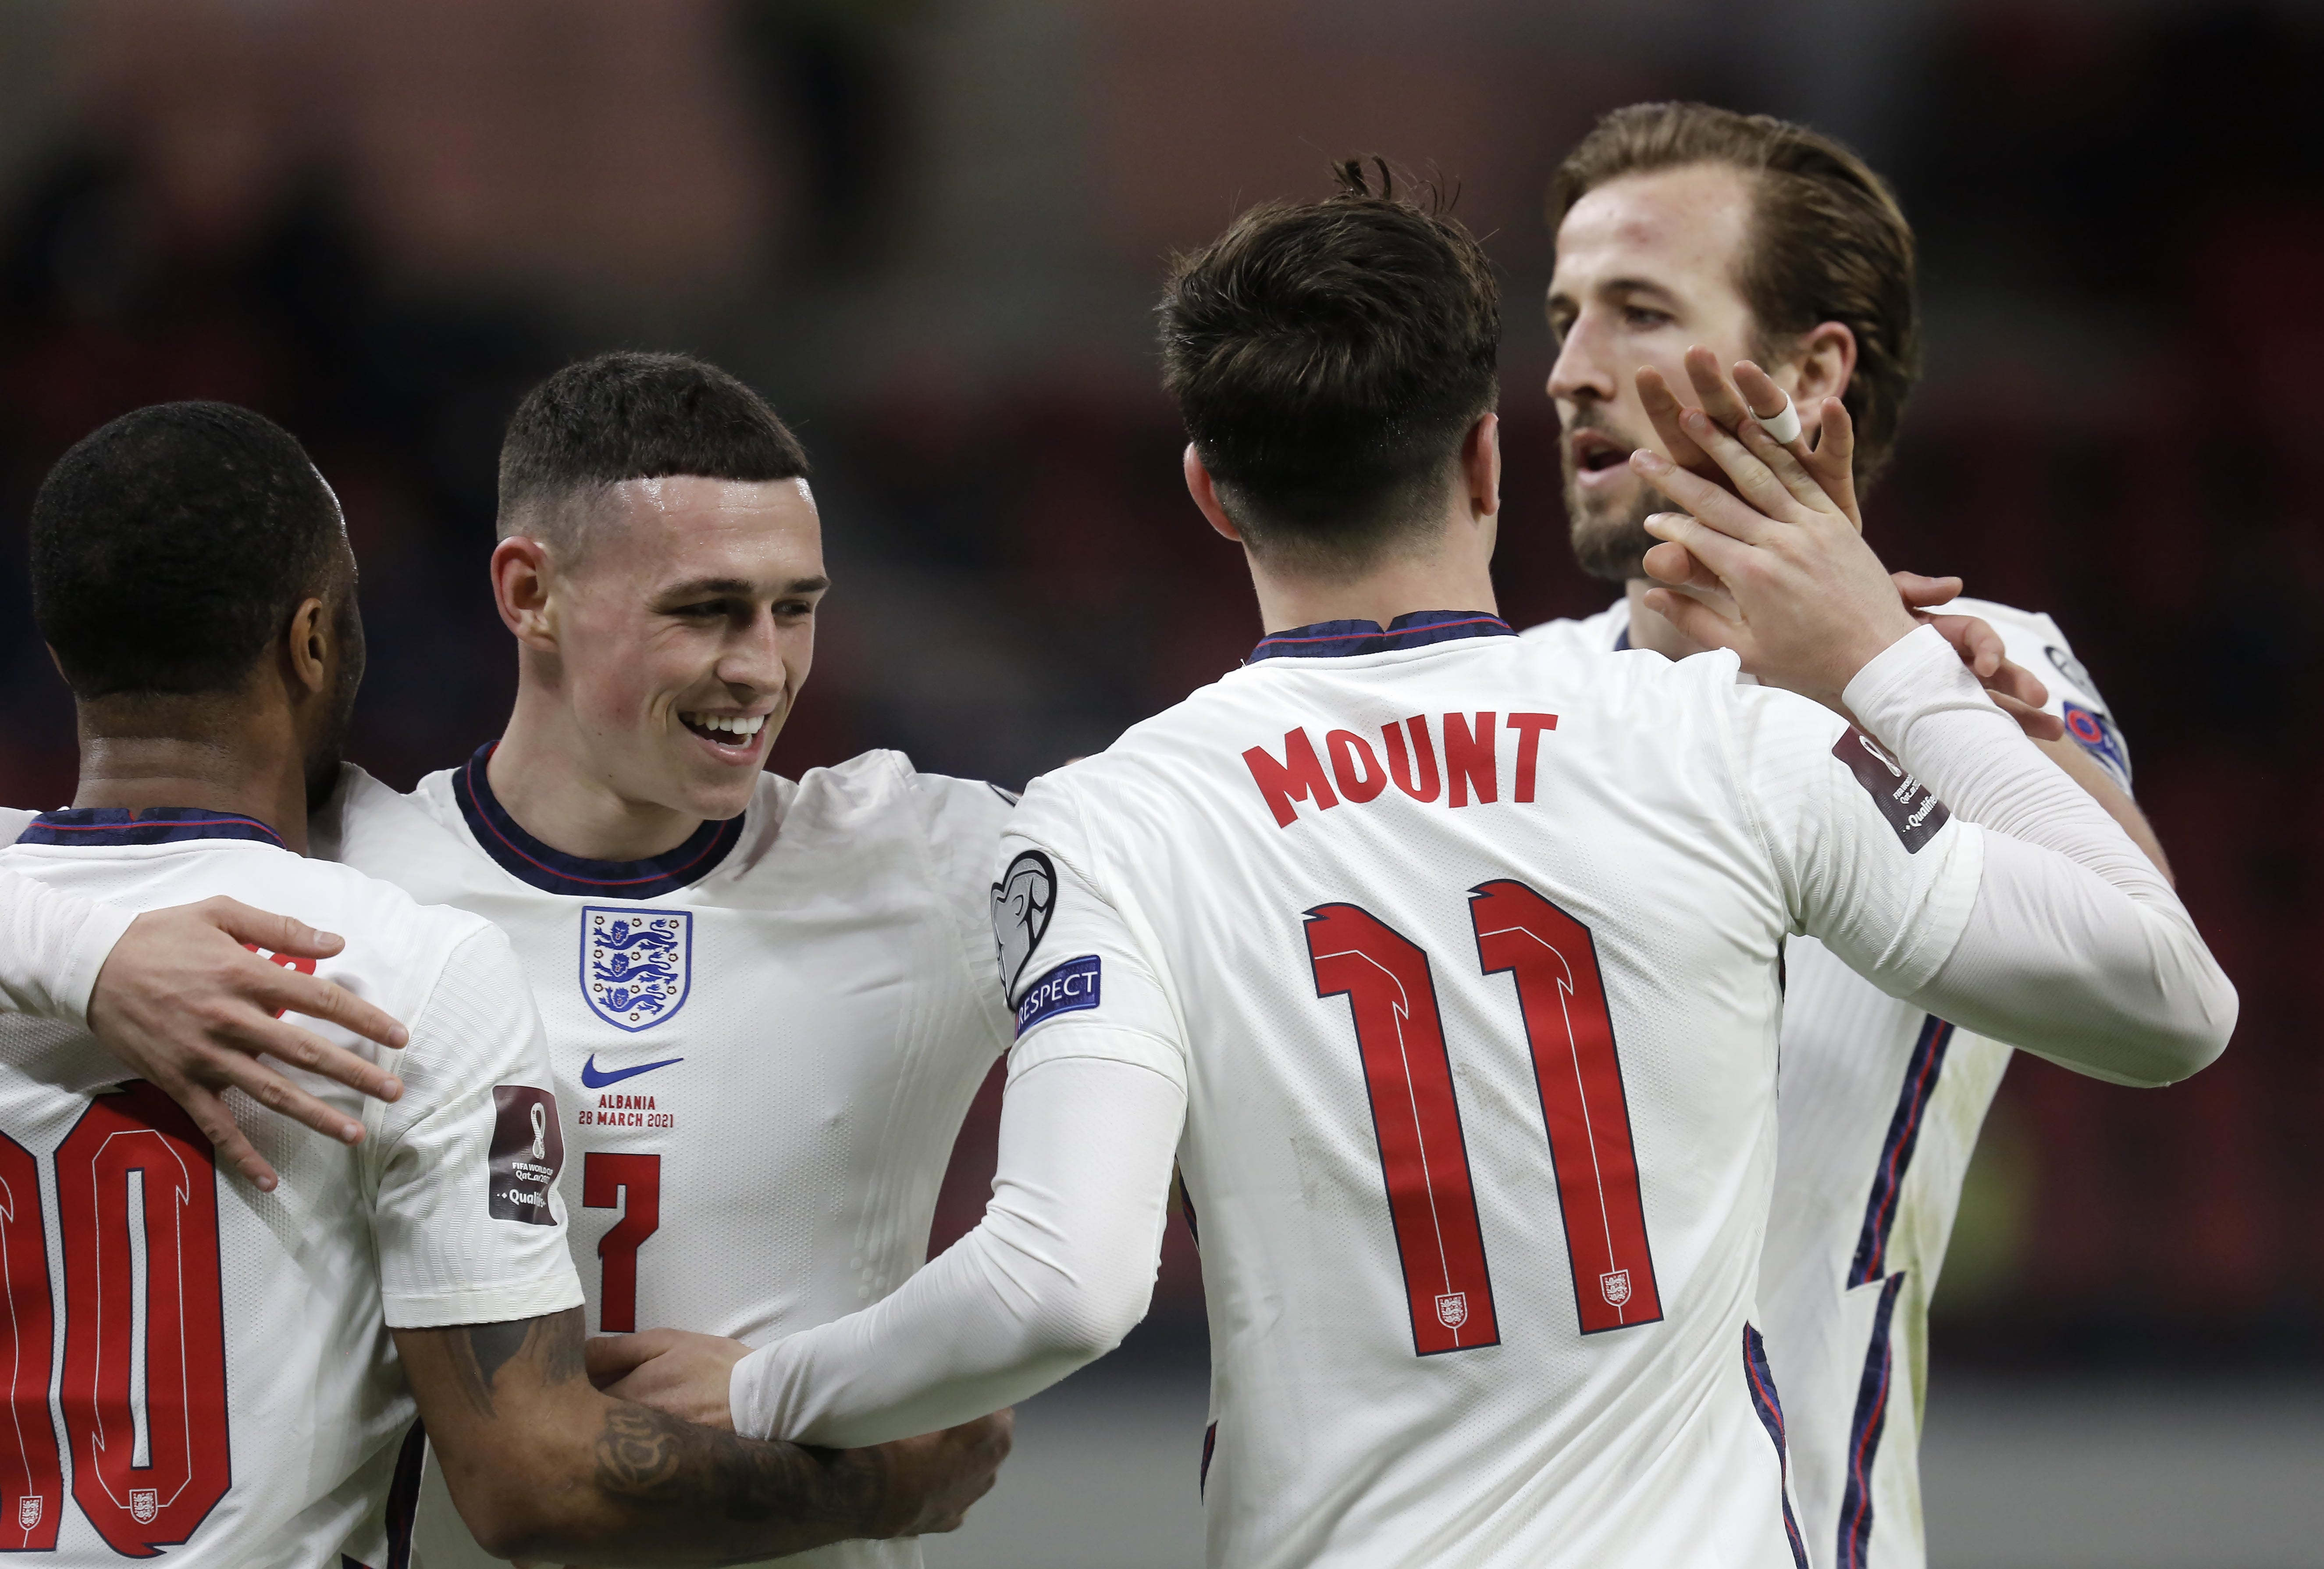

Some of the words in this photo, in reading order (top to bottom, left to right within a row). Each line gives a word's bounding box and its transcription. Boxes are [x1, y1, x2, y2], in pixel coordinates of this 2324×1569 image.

[1242, 711, 1558, 828] MOUNT
[1018, 971, 1098, 1030] RESPECT
[579, 1111, 593, 1125] 28
[597, 1112, 643, 1127] MARCH
[648, 1114, 673, 1128] 2021
[599, 1095, 655, 1110] ALBANIA
[1302, 878, 1664, 1357] 11
[512, 1162, 529, 1170] FIFA
[583, 1152, 661, 1333] 7
